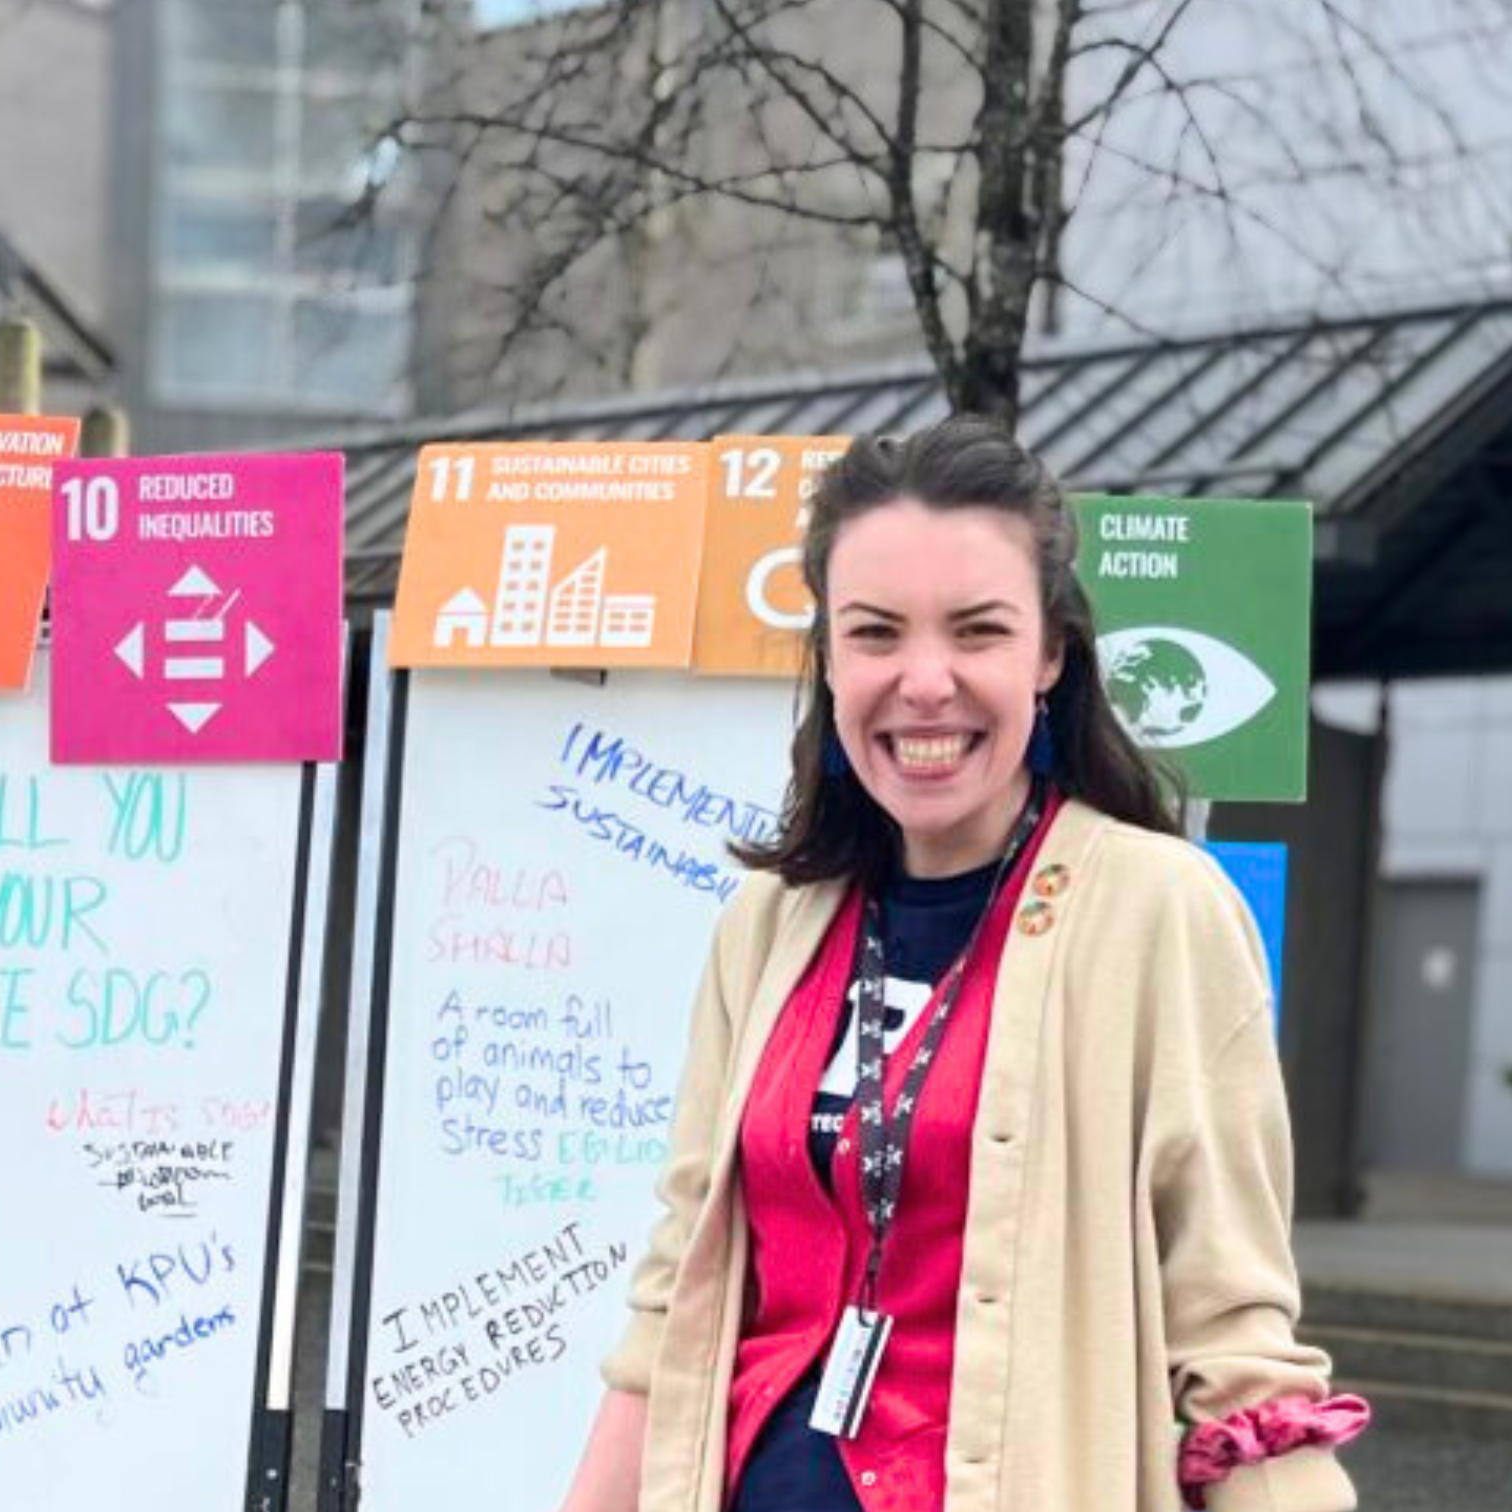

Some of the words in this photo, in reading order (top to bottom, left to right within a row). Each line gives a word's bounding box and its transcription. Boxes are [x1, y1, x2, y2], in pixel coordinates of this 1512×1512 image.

[139, 473, 235, 501] REDUCED
[428, 456, 476, 503] 11
[487, 481, 530, 501] AND
[534, 481, 675, 502] COMMUNITIES
[492, 452, 624, 476] SUSTAINABLE
[628, 453, 692, 476] CITIES
[719, 447, 782, 498] 12
[61, 475, 120, 541] 10
[139, 510, 274, 541] INEQUALITIES
[1099, 513, 1191, 542] CLIMATE
[1098, 551, 1178, 579] ACTION
[100, 770, 189, 863] YOU
[56, 966, 213, 1051] SDG?
[437, 988, 465, 1021] A
[476, 1003, 548, 1032] room
[559, 993, 613, 1040] full
[431, 1023, 470, 1062] of
[483, 1040, 603, 1086] animals
[617, 1045, 653, 1090] to
[436, 1066, 500, 1117] play
[514, 1075, 568, 1121] and
[580, 1085, 672, 1128] reduce
[116, 1229, 237, 1306] KPU's
[382, 1221, 586, 1354] IMPLEMENT
[123, 1303, 237, 1393] gardens
[372, 1342, 471, 1411] ENERGY
[397, 1322, 567, 1439] PROCEDURES
